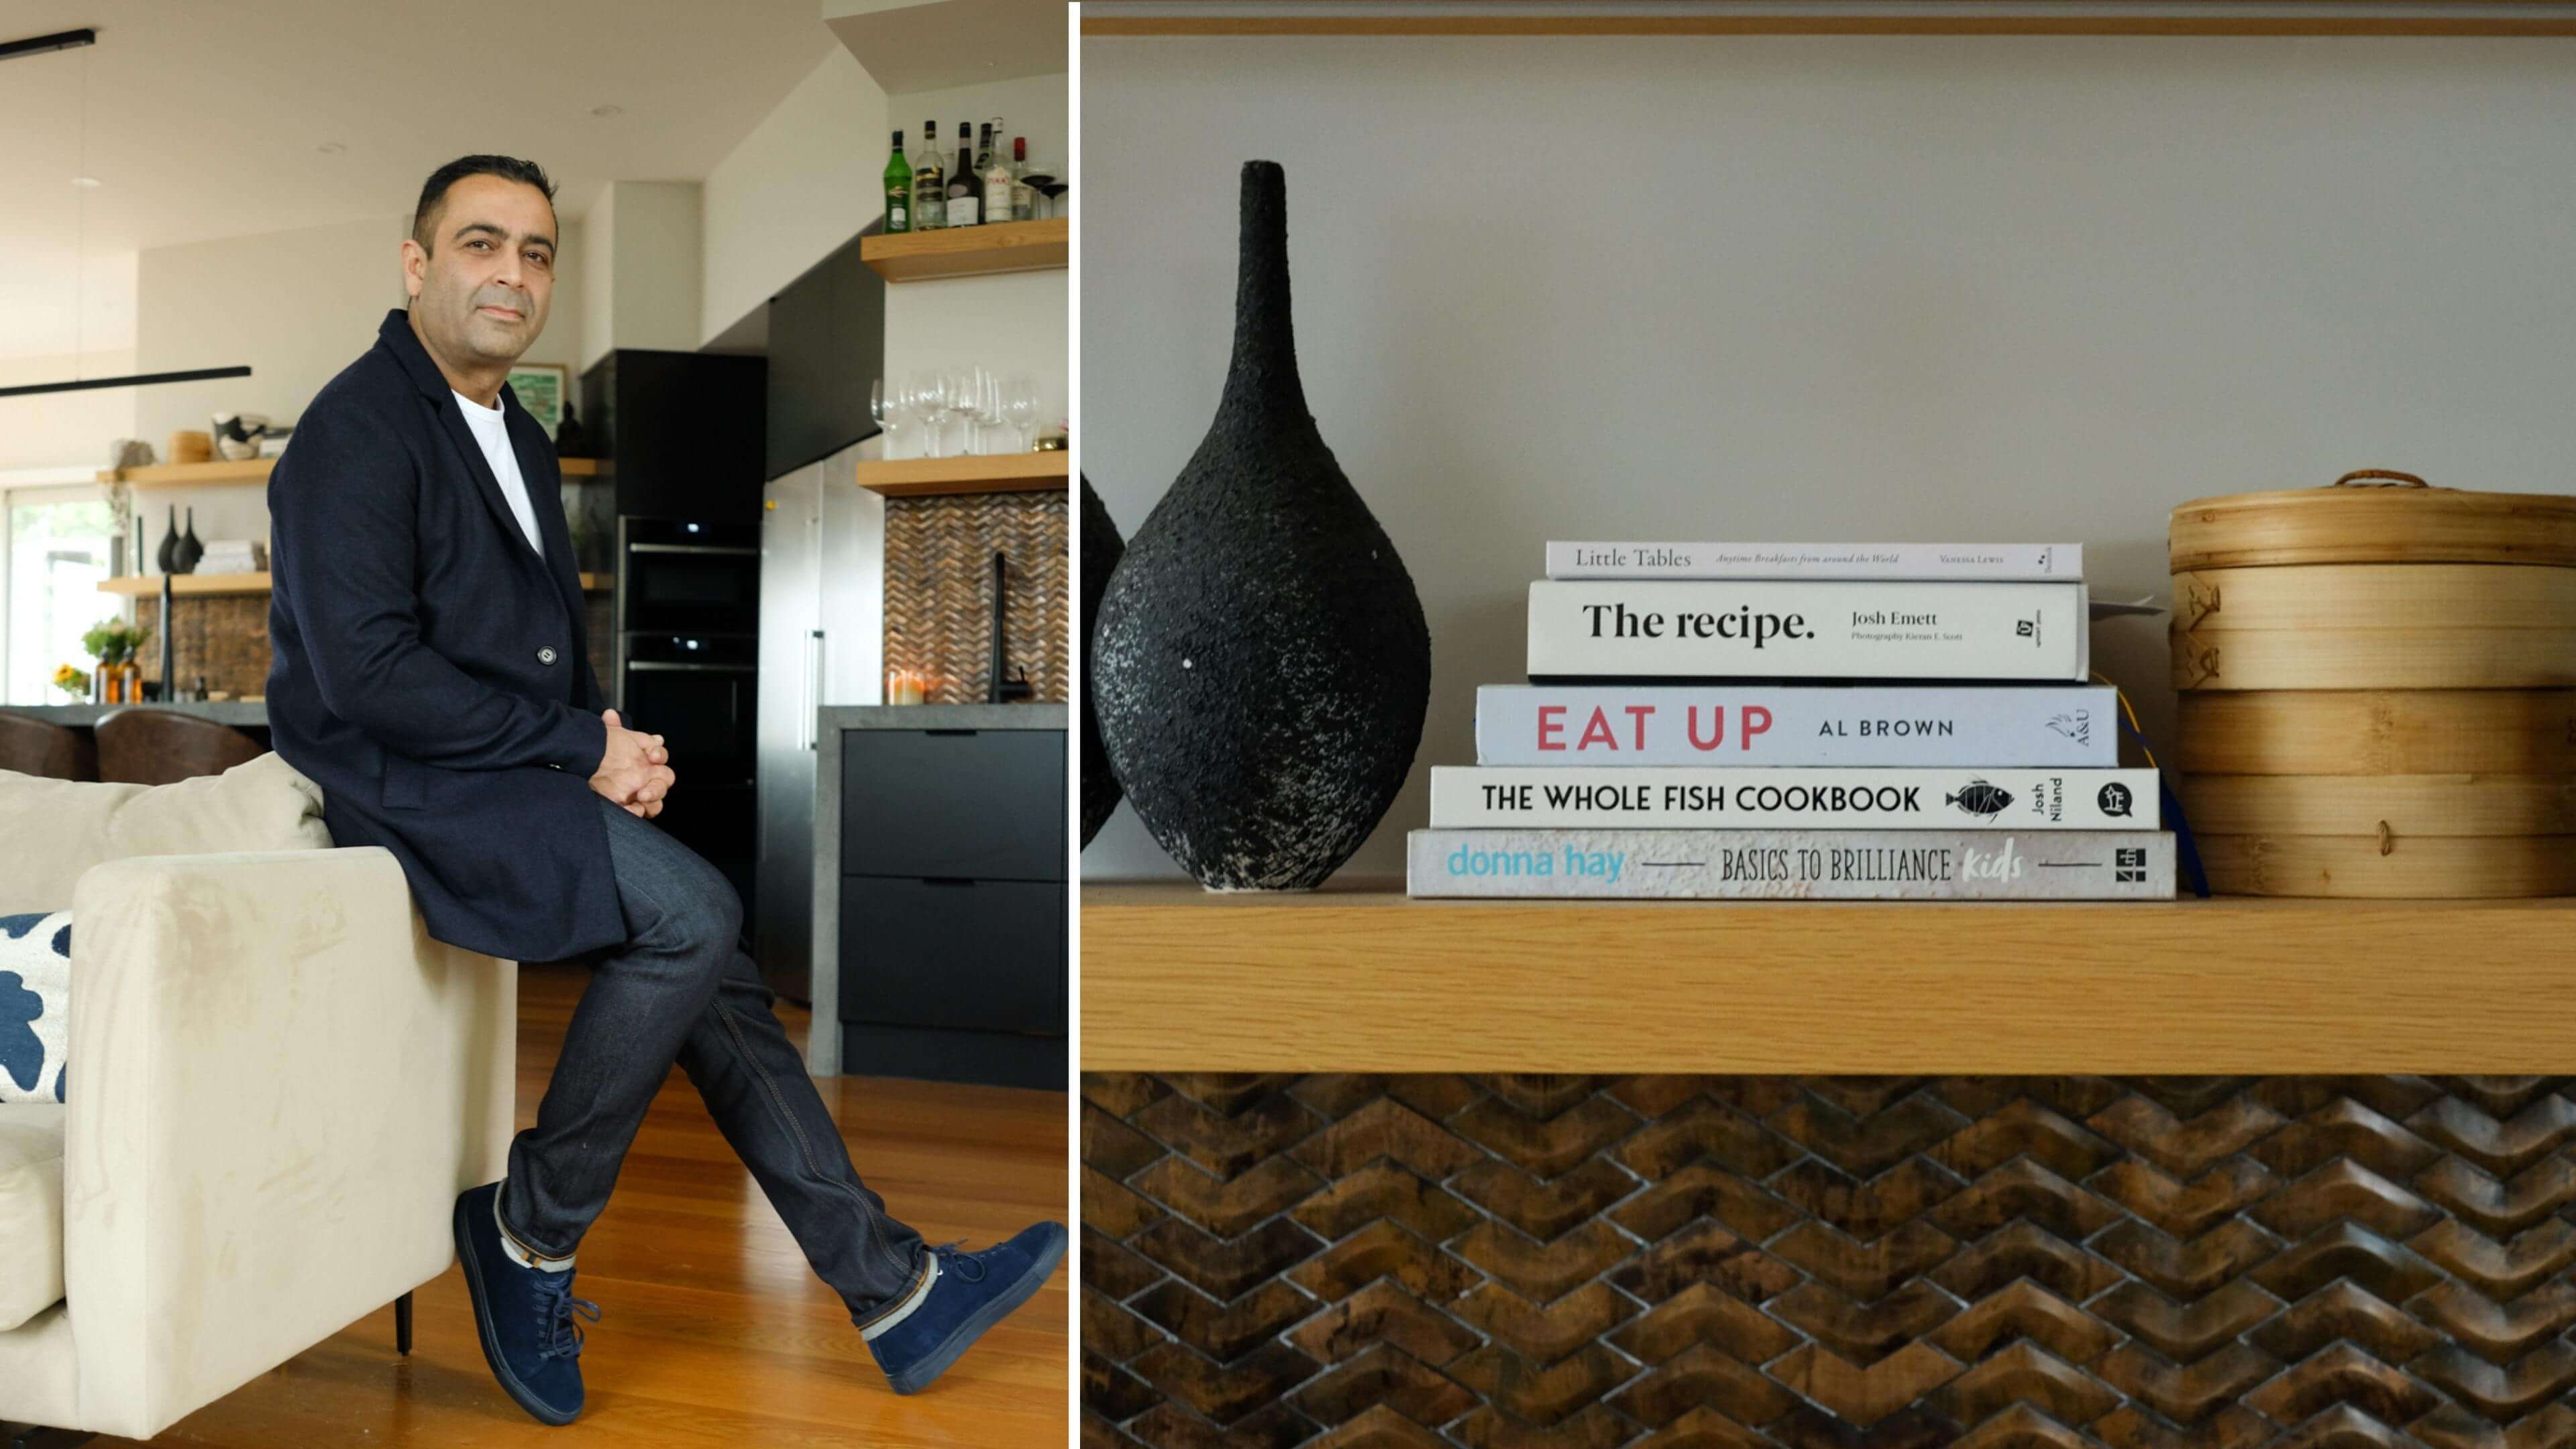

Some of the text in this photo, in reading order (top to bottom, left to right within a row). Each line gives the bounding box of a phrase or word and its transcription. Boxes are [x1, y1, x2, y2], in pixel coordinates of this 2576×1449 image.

[1576, 548, 1691, 567] Little Tables
[1715, 553, 1900, 566] Anytime Breakfasts from around the World
[1582, 602, 1815, 649] The recipe.
[1852, 611, 1937, 627] Josh Emett
[1851, 632, 1904, 642] Photography
[1942, 633, 1963, 641] Scott
[1537, 705, 1773, 751] EAT UP
[1818, 719, 1953, 737] AL BROWN
[2076, 708, 2090, 747] A&U
[1481, 785, 1921, 812] THE WHOLE FISH COOKBOOK
[2031, 783, 2045, 815] Josh
[2049, 777, 2062, 822] Niland
[1447, 843, 1625, 884] donna hay
[1721, 849, 1789, 881] BASICS
[1798, 849, 1821, 881] TO
[1830, 849, 1951, 881] BRILLIANCE
